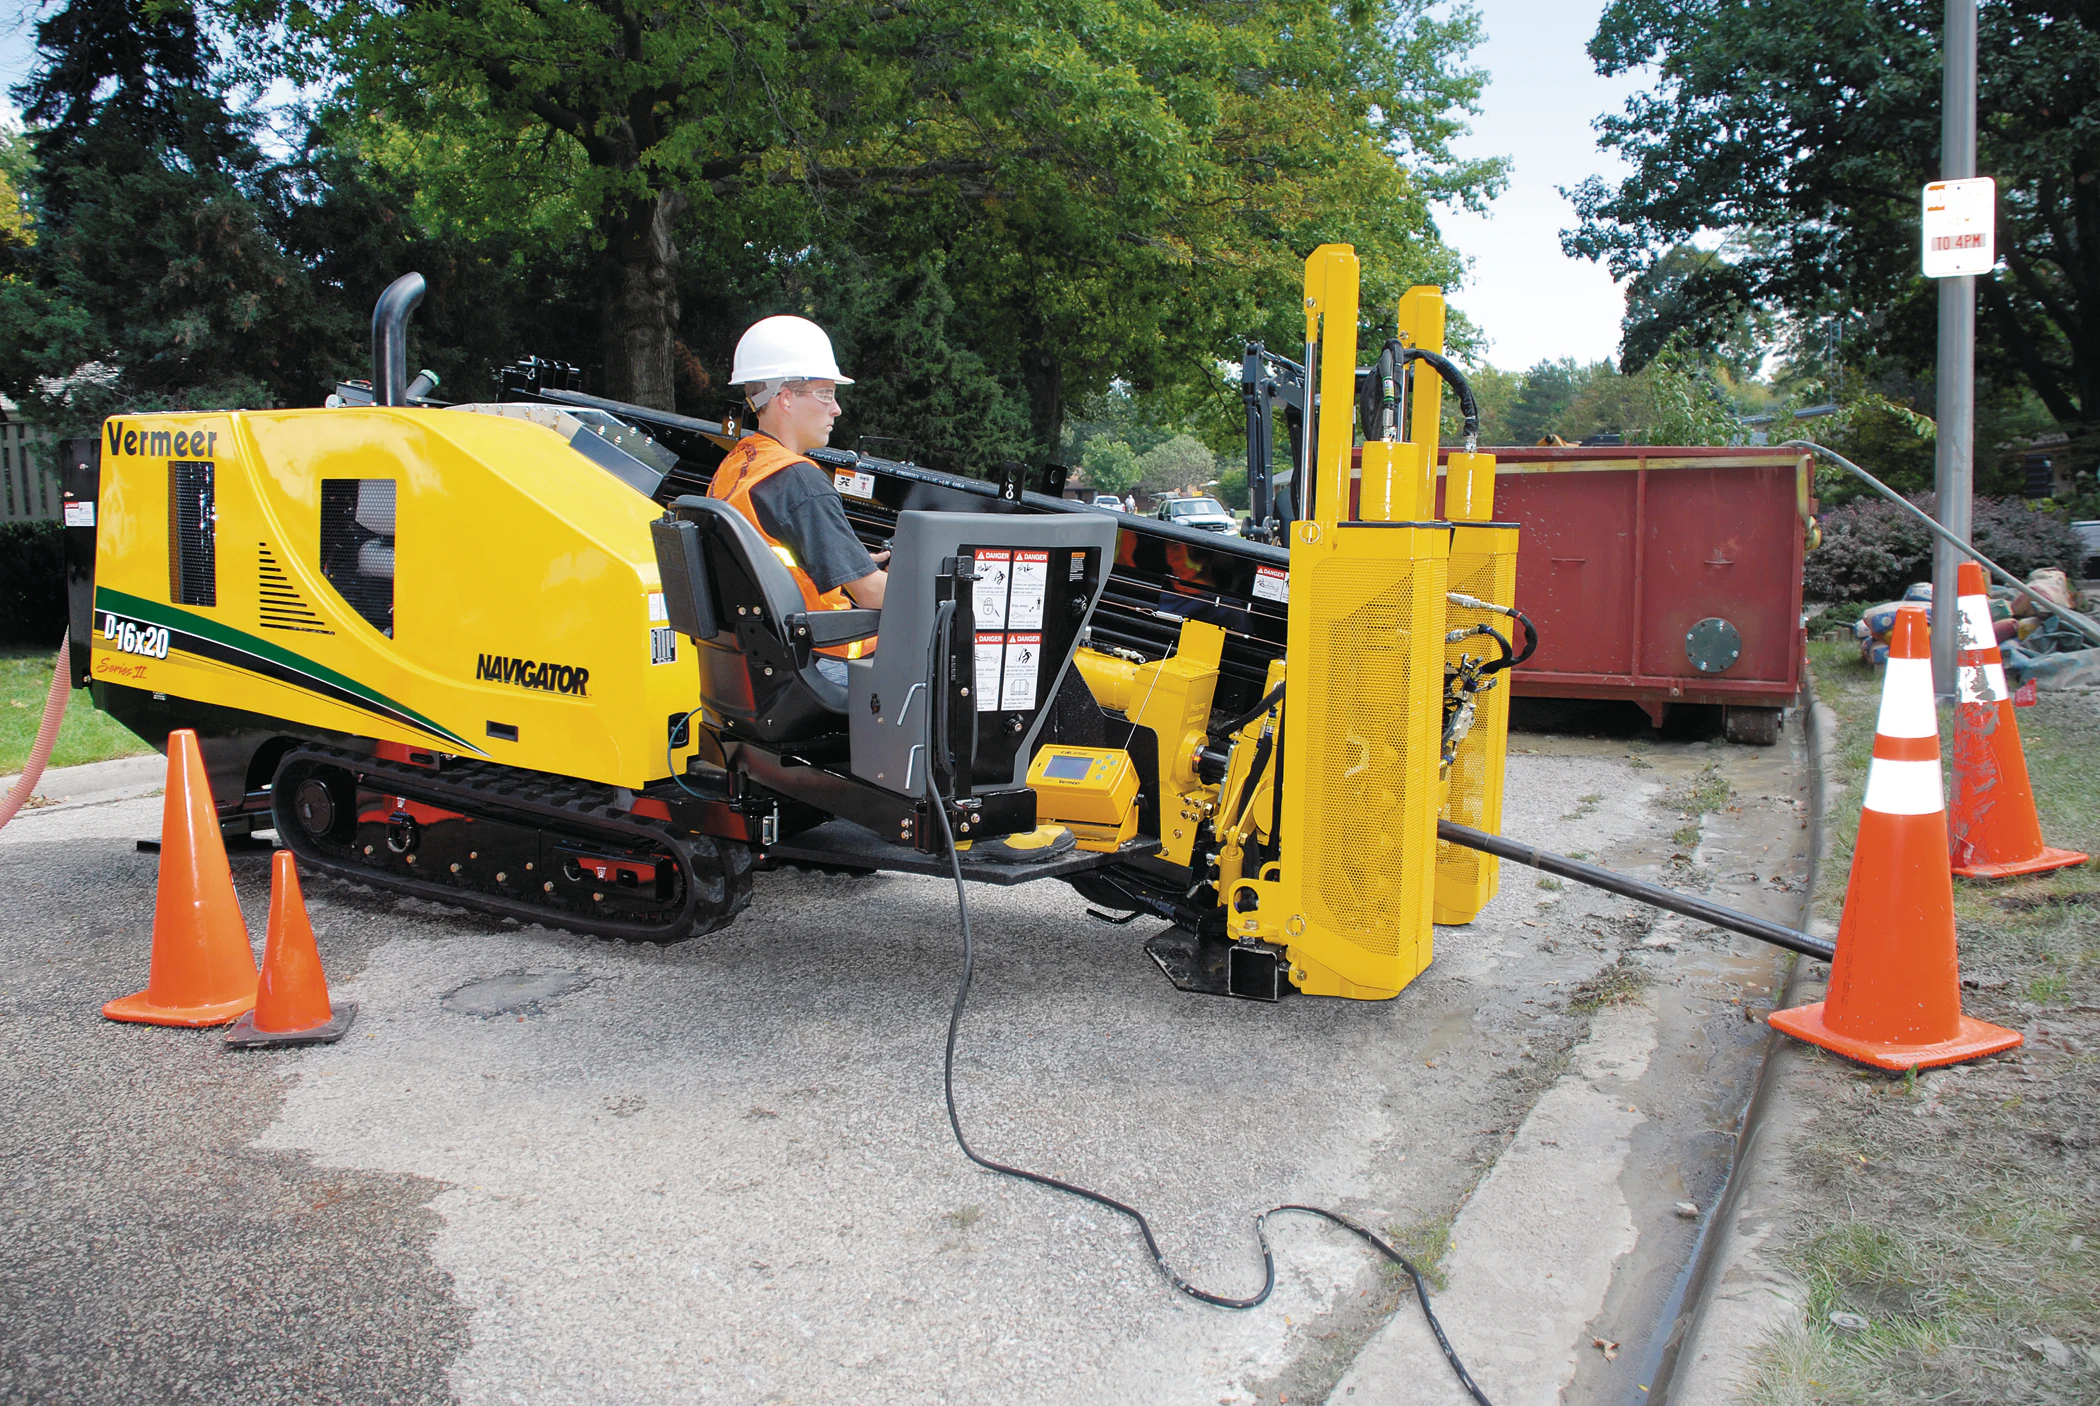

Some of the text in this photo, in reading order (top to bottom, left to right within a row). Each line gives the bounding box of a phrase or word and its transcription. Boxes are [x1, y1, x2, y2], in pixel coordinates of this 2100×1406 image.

[1936, 234, 1981, 250] TO 4PM
[107, 421, 217, 458] Vermeer
[1264, 569, 1284, 578] DANGER
[104, 613, 170, 661] D16x20
[96, 657, 148, 680] Series II
[476, 653, 589, 696] NAVIGATOR
